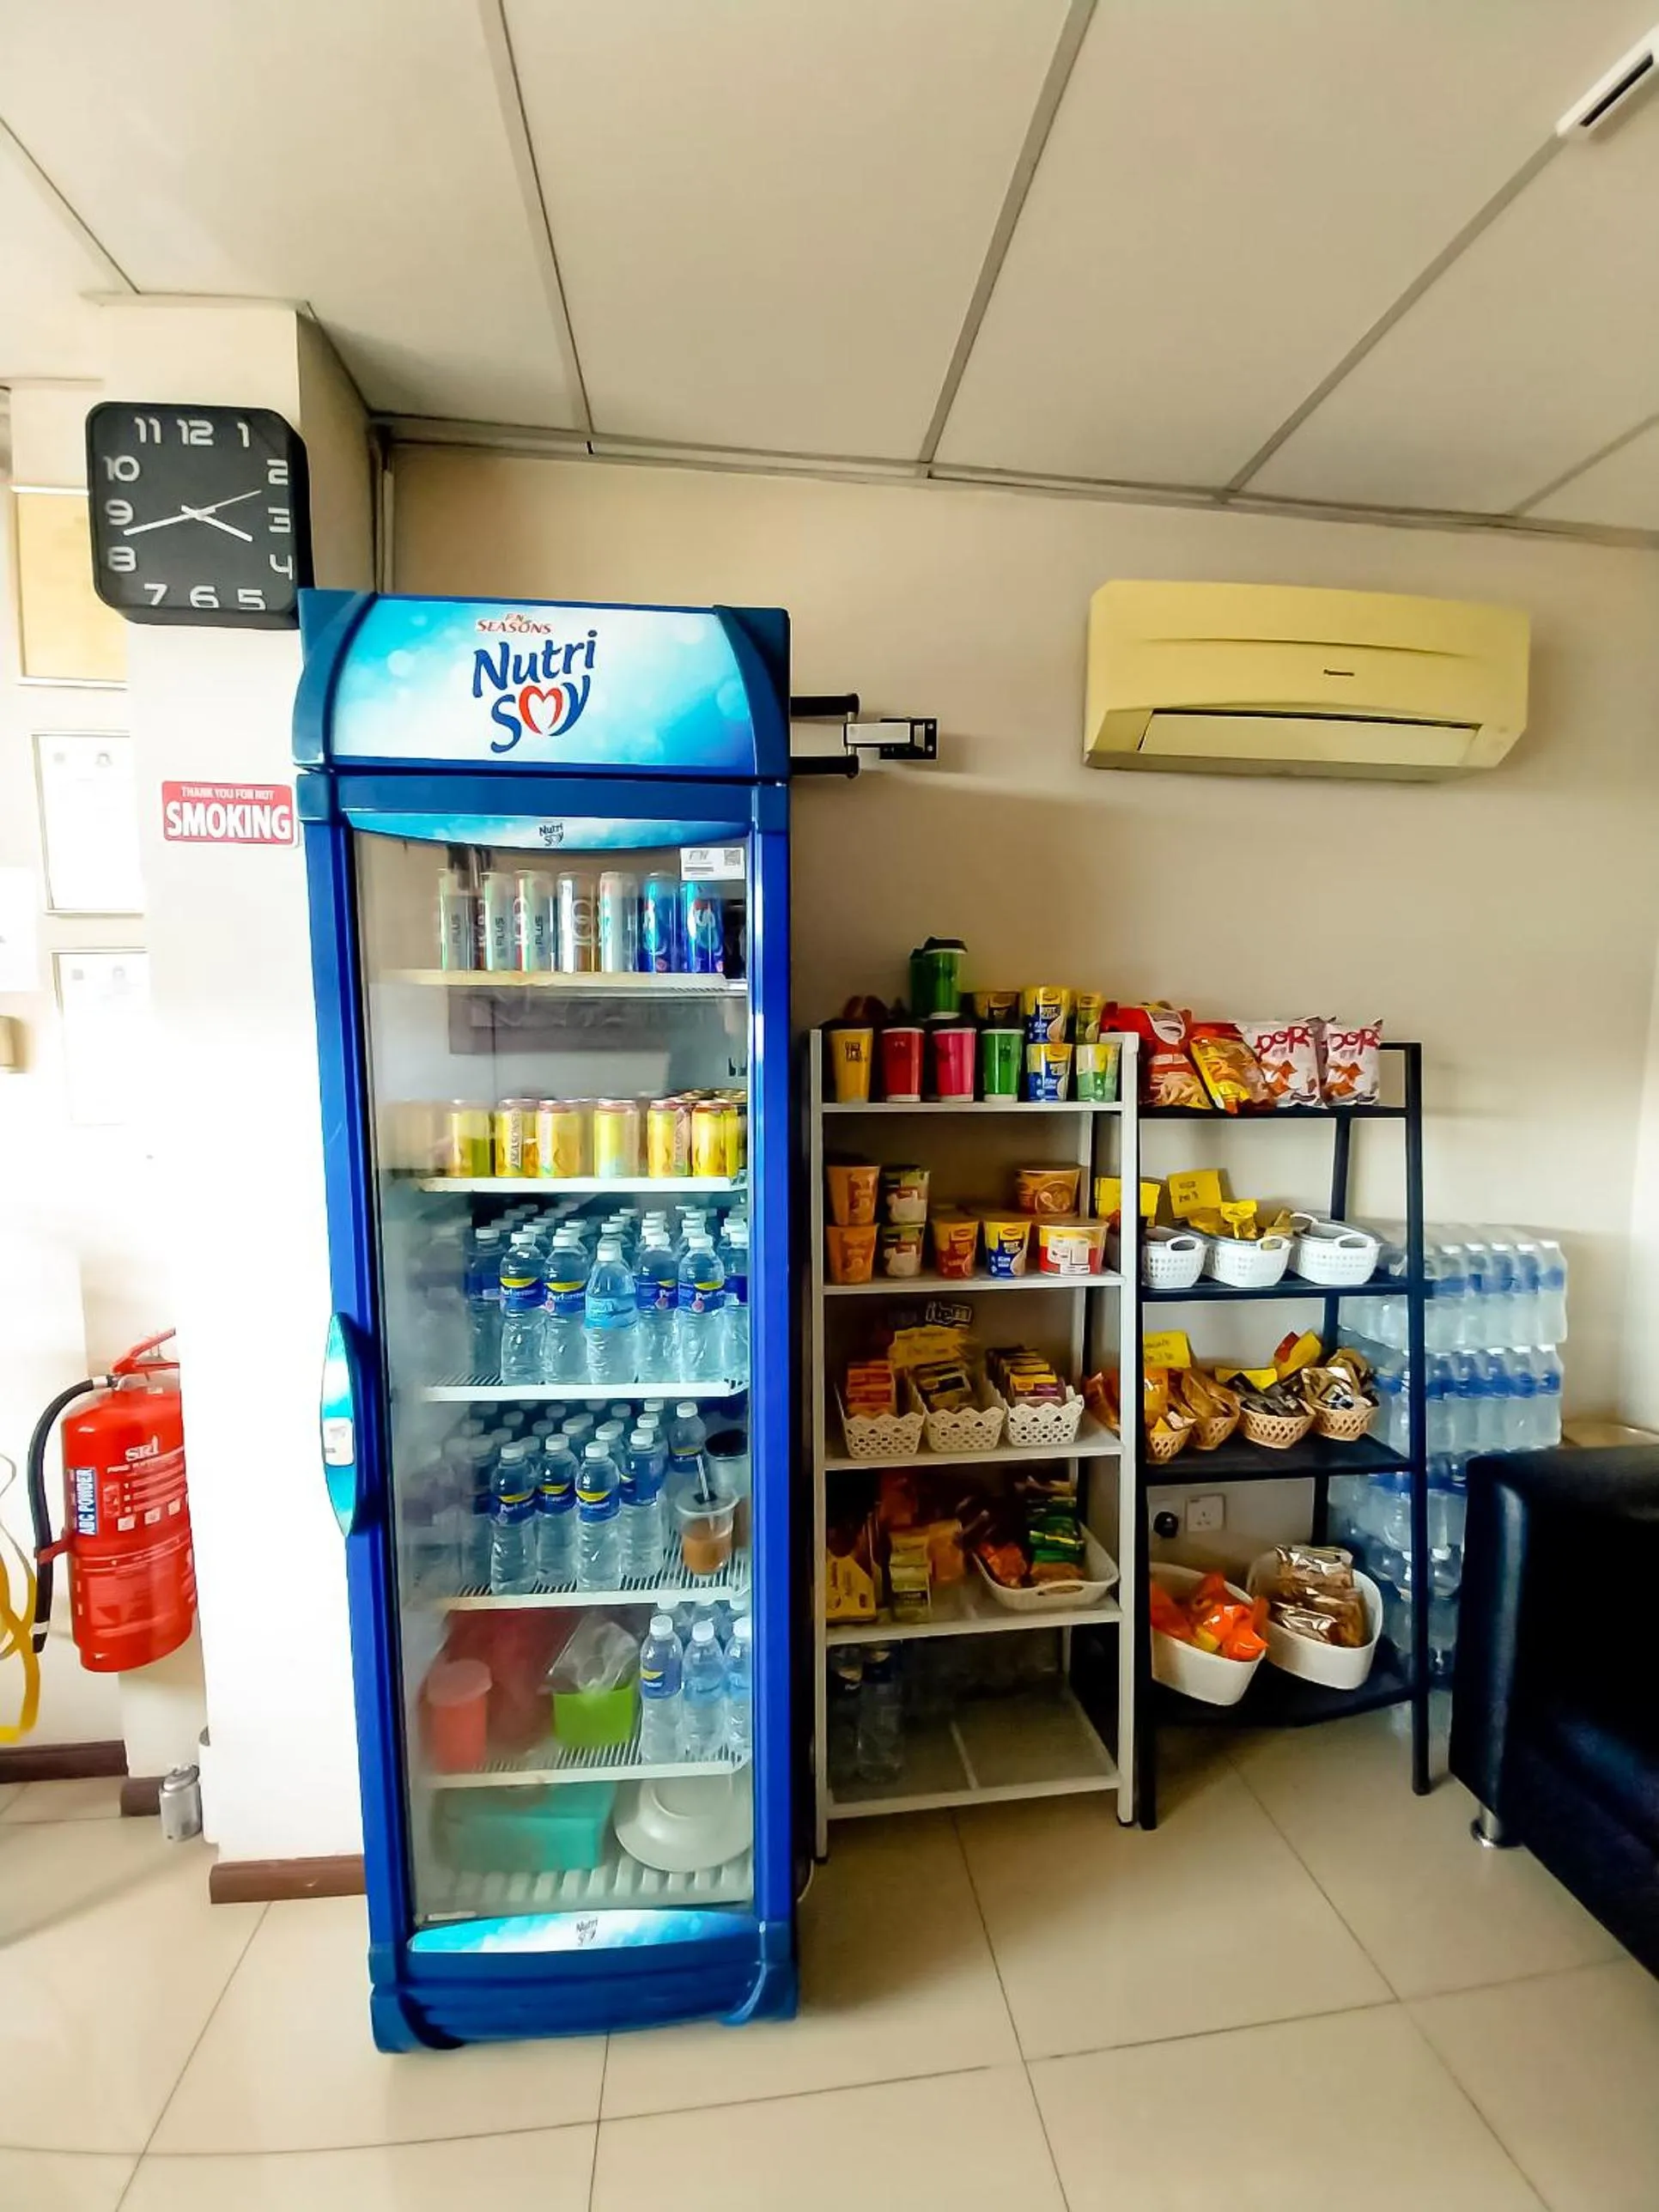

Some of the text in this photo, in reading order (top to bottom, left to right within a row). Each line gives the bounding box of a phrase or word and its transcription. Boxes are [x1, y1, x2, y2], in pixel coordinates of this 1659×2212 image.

[134, 416, 162, 444] 11
[176, 419, 215, 446] 12
[237, 422, 250, 447] 1
[103, 455, 141, 482] 10
[266, 459, 289, 485] 2
[105, 499, 134, 526] 9
[267, 507, 291, 533] 3
[107, 545, 137, 572] 8
[269, 554, 293, 580] 4
[143, 583, 168, 605] 7
[189, 585, 220, 609] 6
[237, 588, 266, 611] 5
[477, 619, 552, 635] SEASONS
[471, 629, 598, 698] Nutri
[181, 787, 275, 800] THANK YOU FOR NOT
[166, 800, 292, 840] SMOKING
